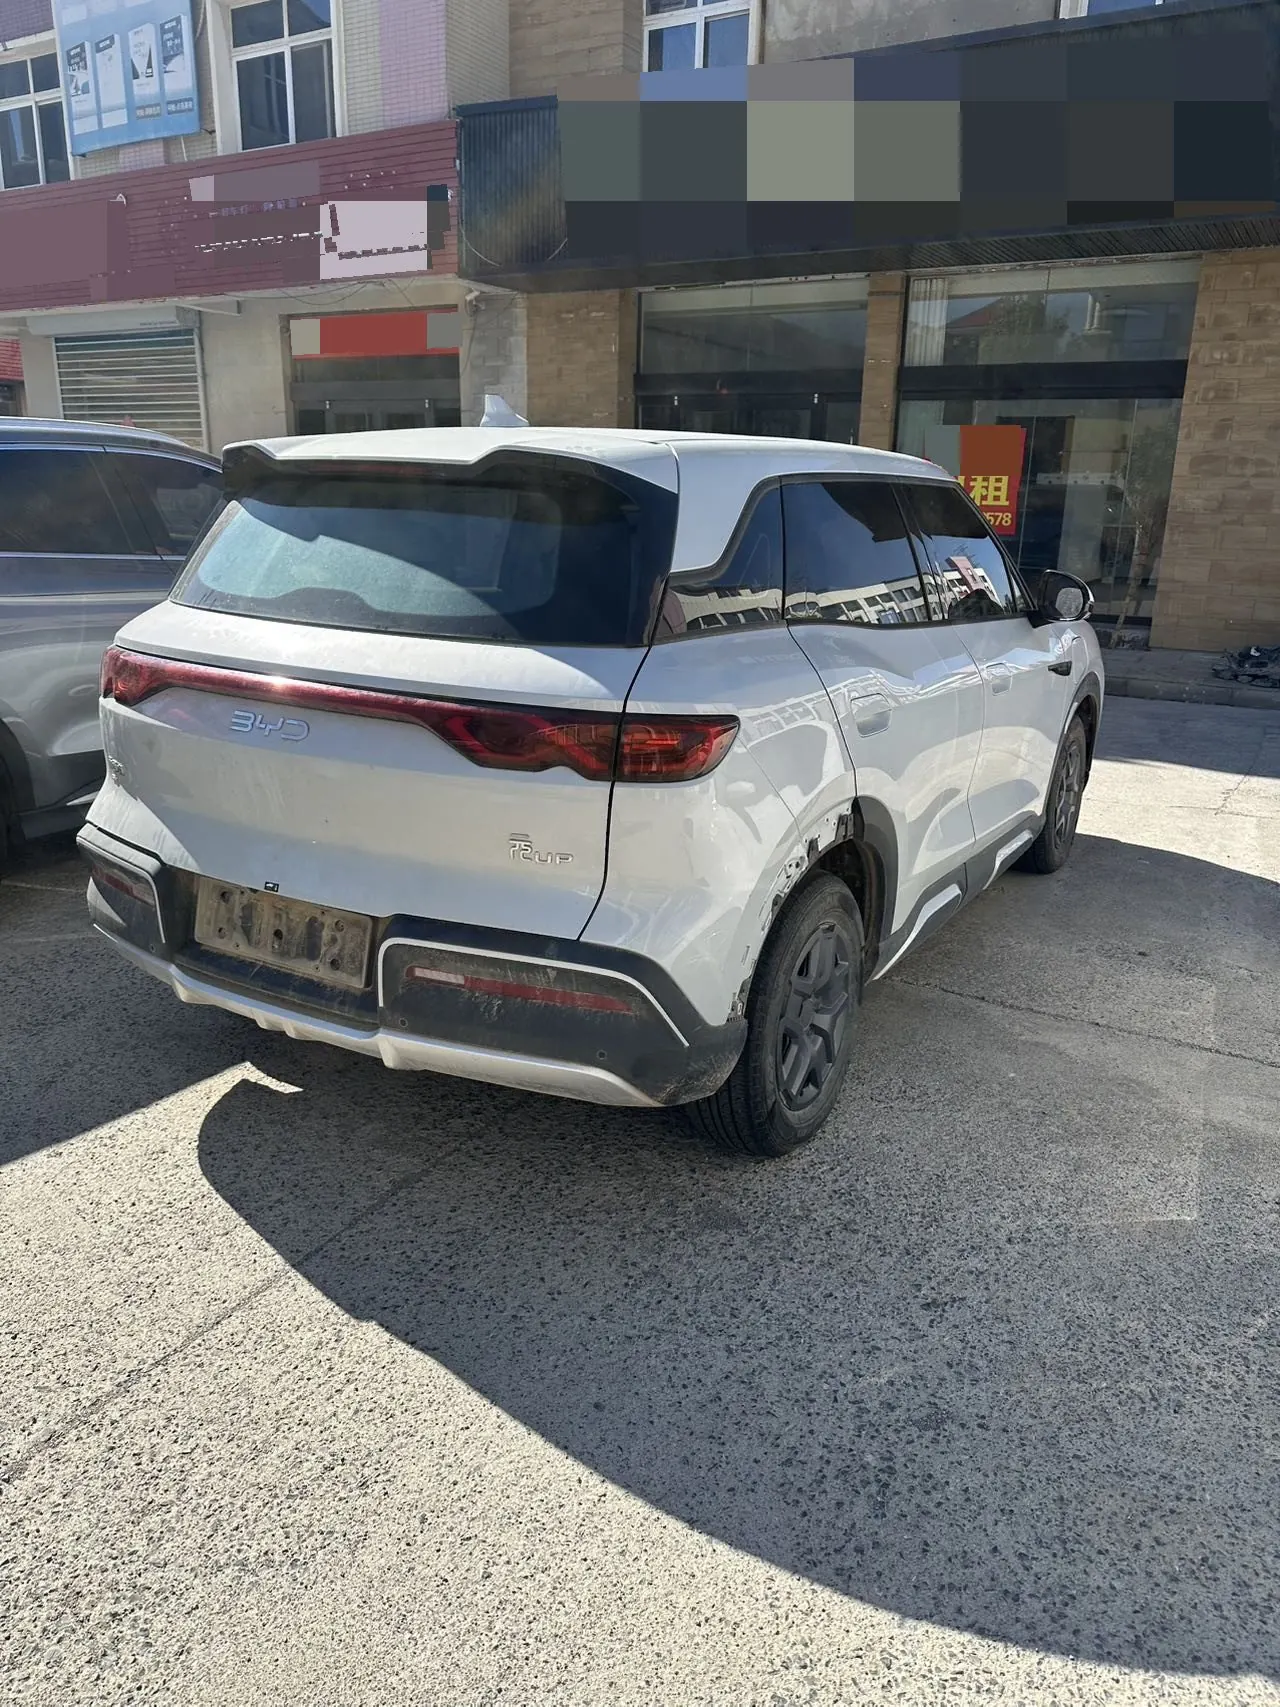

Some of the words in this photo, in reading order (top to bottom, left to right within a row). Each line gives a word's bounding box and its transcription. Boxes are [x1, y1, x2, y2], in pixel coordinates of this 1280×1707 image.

[957, 475, 1010, 507] 租
[983, 512, 1012, 527] 578
[230, 709, 309, 741] BYD
